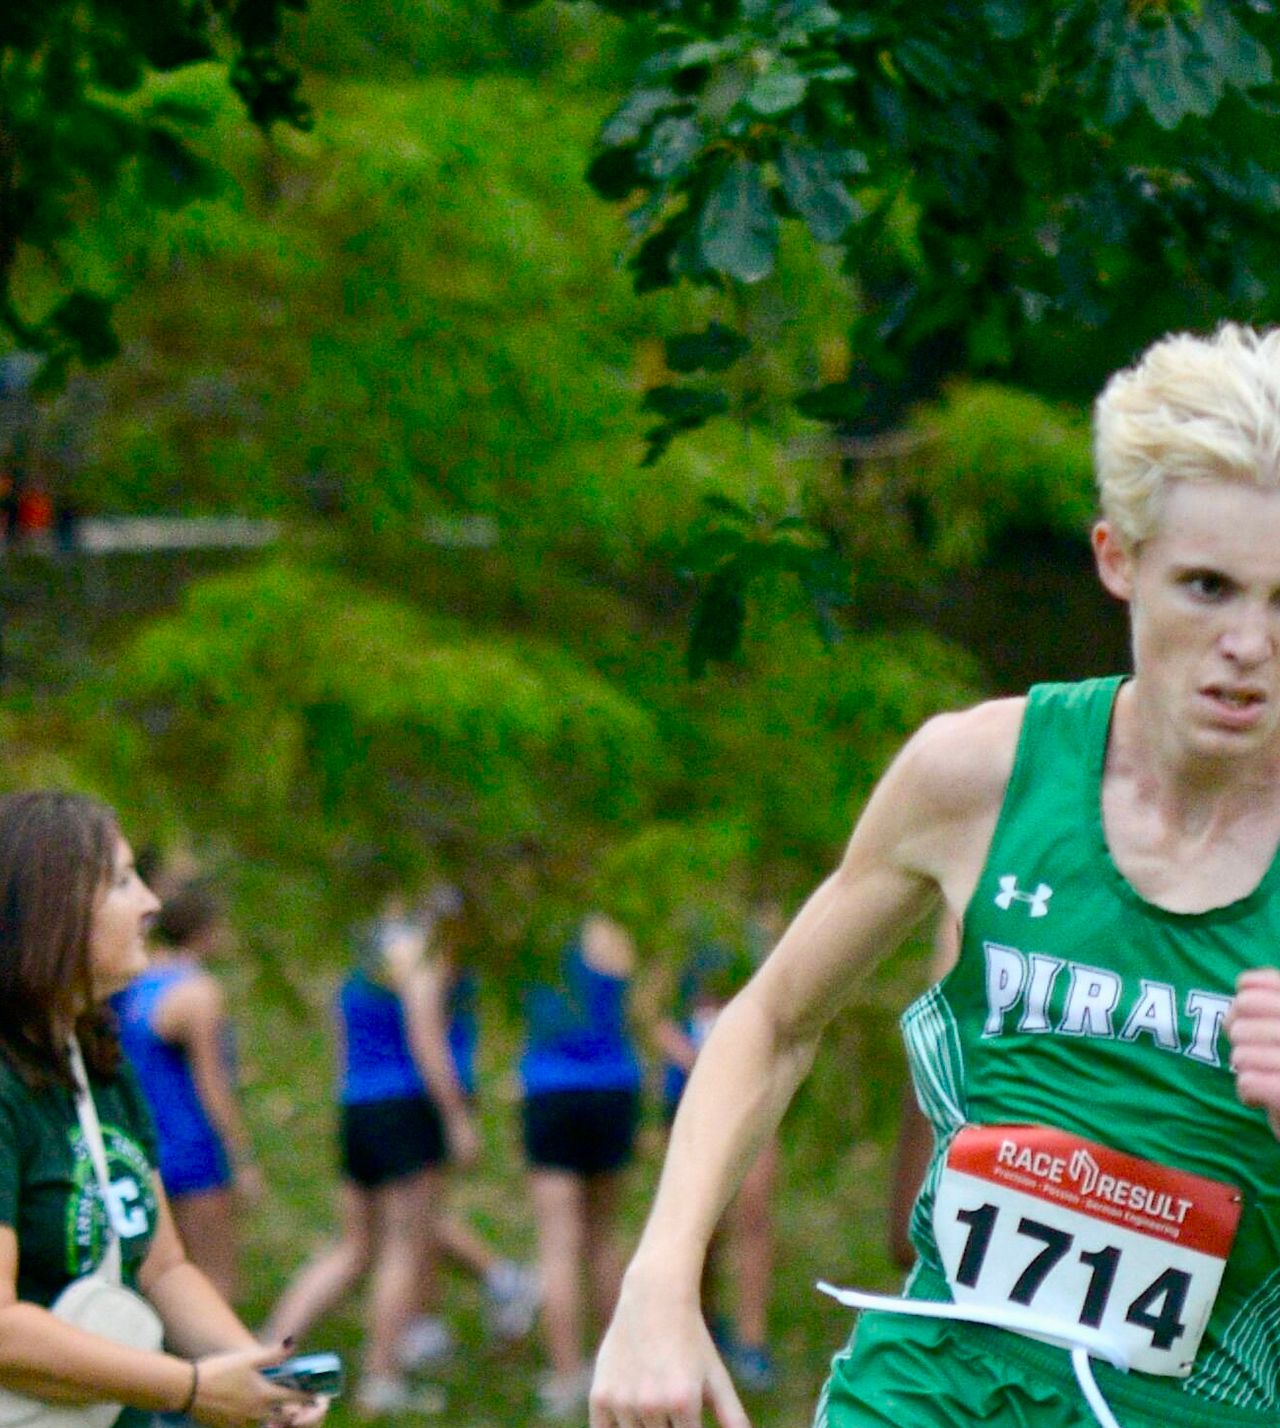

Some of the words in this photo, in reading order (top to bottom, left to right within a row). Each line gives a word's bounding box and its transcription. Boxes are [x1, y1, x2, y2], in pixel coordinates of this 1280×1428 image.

[997, 1140, 1066, 1182] RACE
[1096, 1175, 1193, 1224] RESULT
[955, 1202, 1193, 1351] 1714
